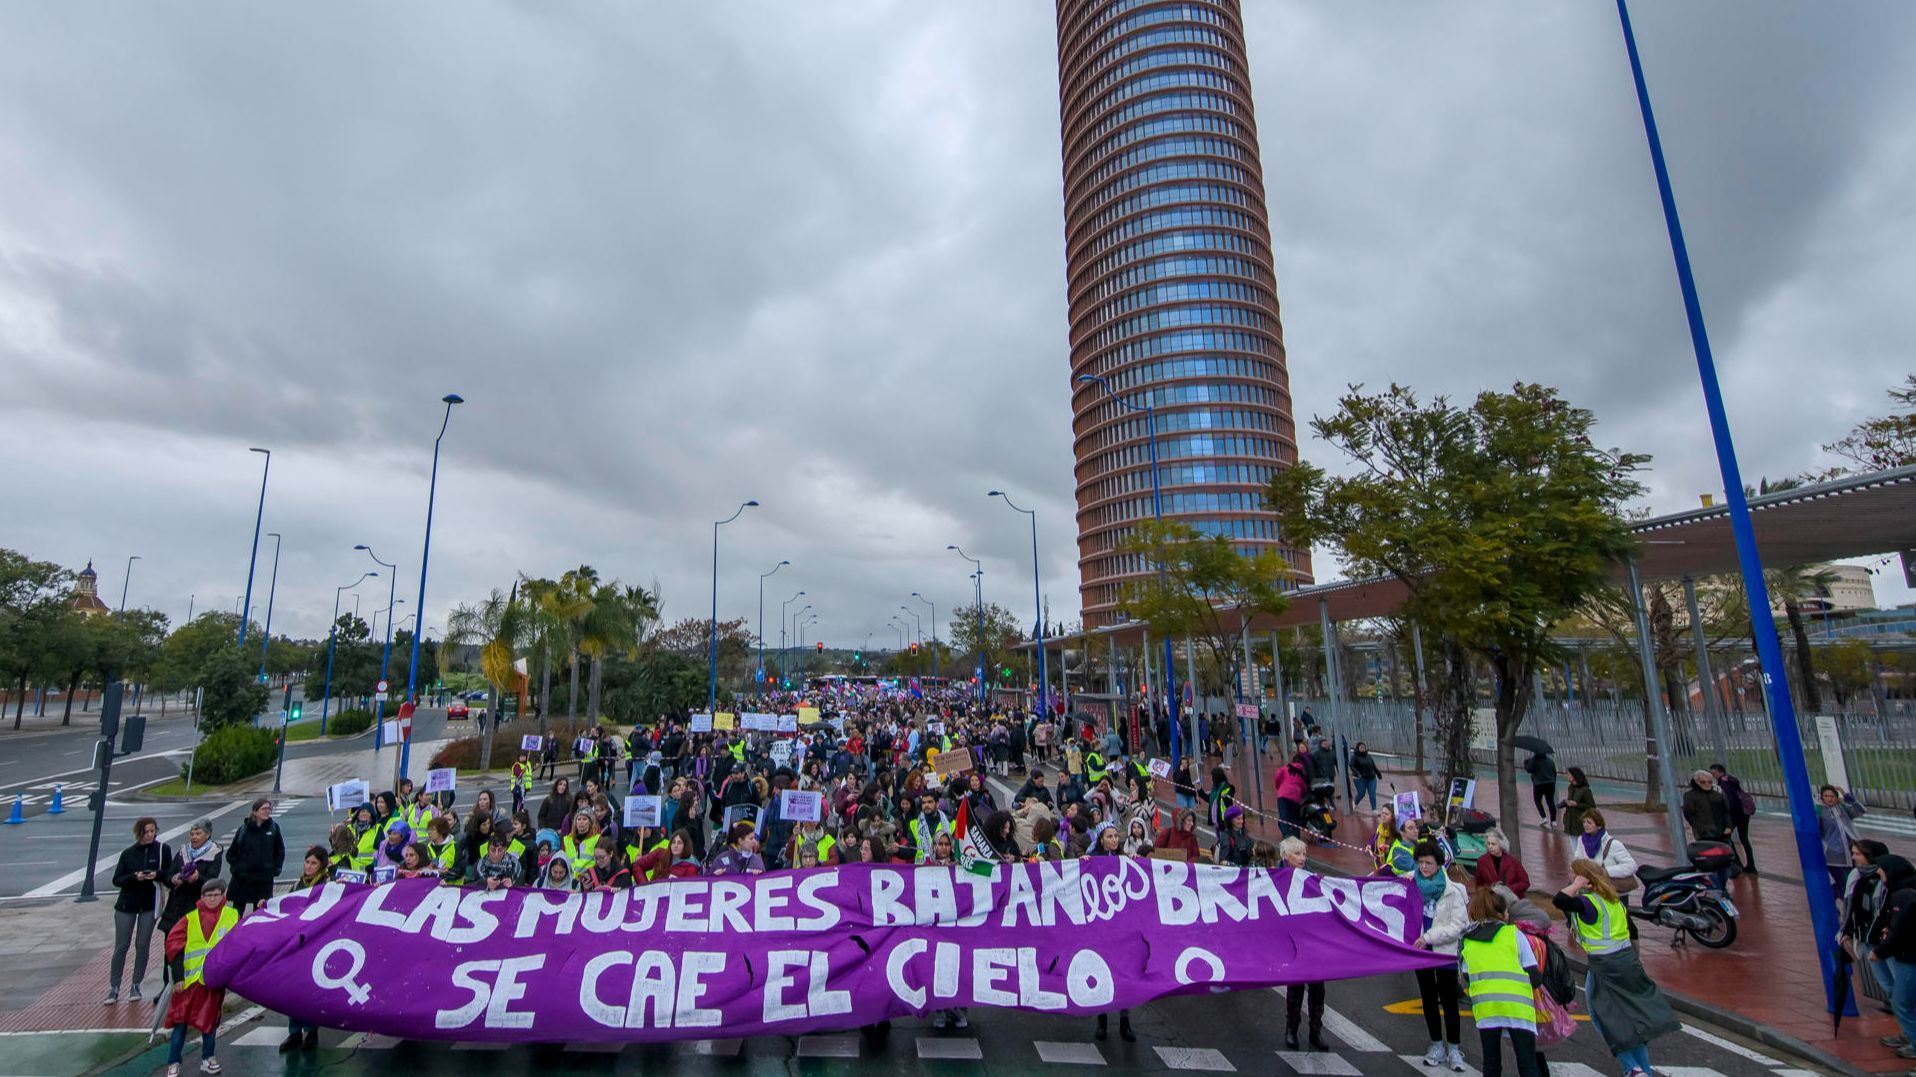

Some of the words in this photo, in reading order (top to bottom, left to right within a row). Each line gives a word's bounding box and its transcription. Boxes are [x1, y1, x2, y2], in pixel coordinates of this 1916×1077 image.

[970, 825, 994, 859] SAHARA
[355, 882, 509, 944] LAS
[513, 868, 841, 939] MUJERES
[871, 859, 1087, 927] BAJAN
[1080, 856, 1150, 923] los
[435, 953, 547, 1029] SE
[580, 950, 727, 1028] CAE
[763, 950, 852, 1023] EL
[887, 938, 1115, 1009] CIELO
